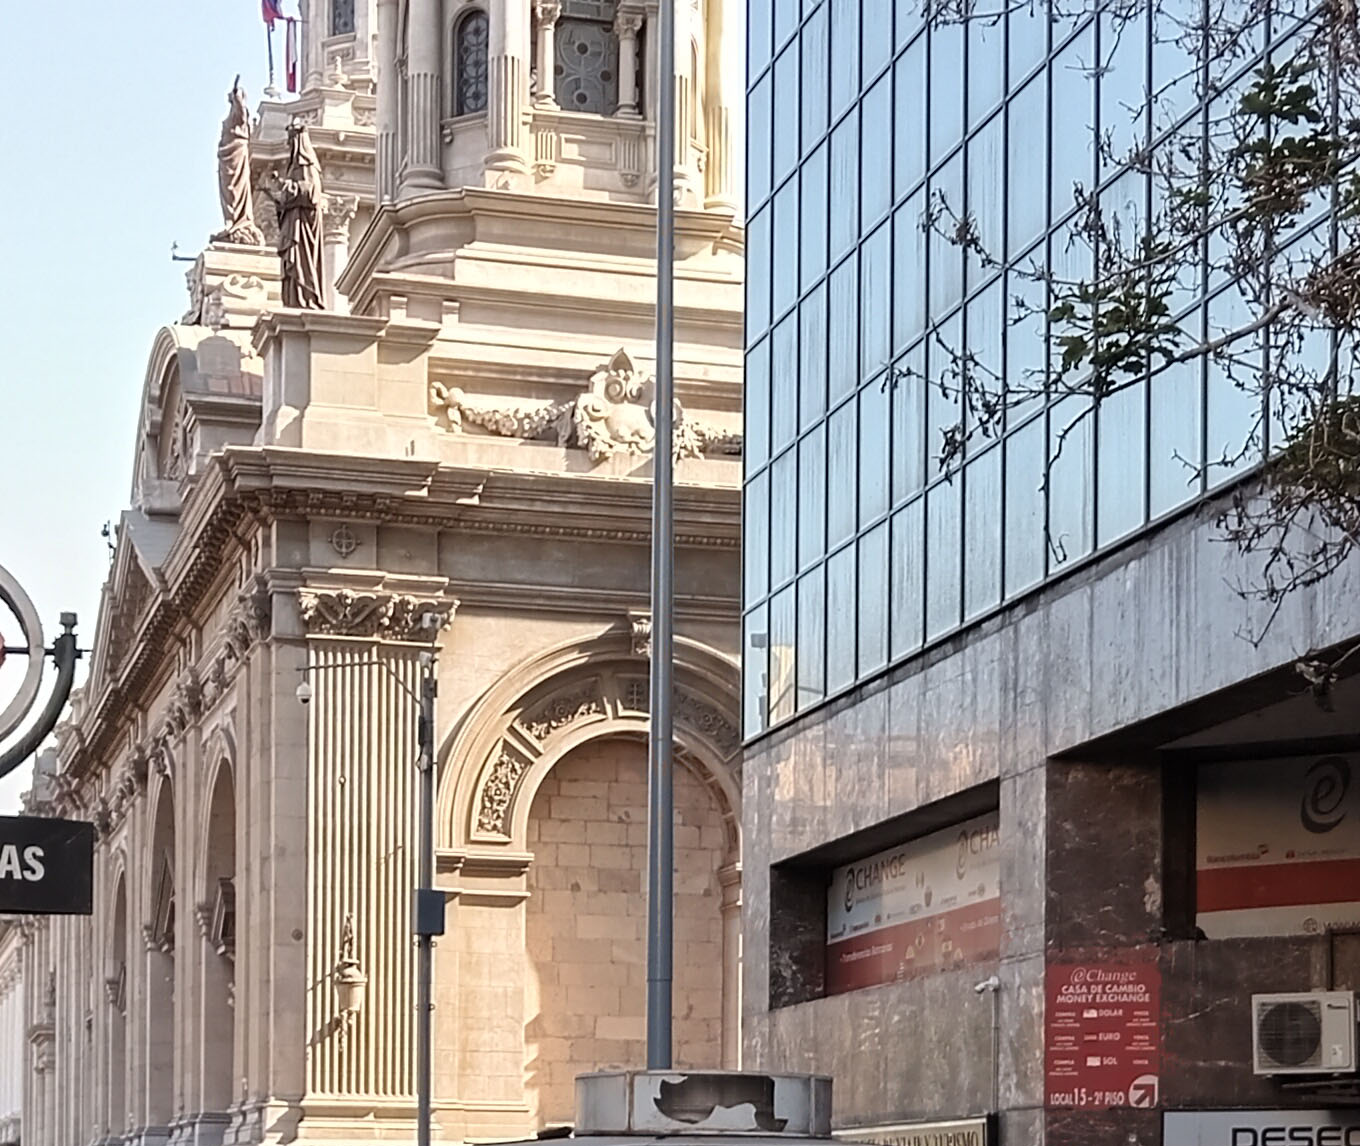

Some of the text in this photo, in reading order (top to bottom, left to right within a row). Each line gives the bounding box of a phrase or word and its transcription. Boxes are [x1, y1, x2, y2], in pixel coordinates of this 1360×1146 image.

[1061, 984, 1146, 994] CASA DE CAMBIO
[1056, 993, 1150, 1004] MONEY EXCHANGE
[1099, 1009, 1123, 1017] DOLAR
[1099, 1032, 1120, 1041] EURO
[1050, 1092, 1073, 1105] LOCAL
[1104, 1091, 1125, 1105] PISO
